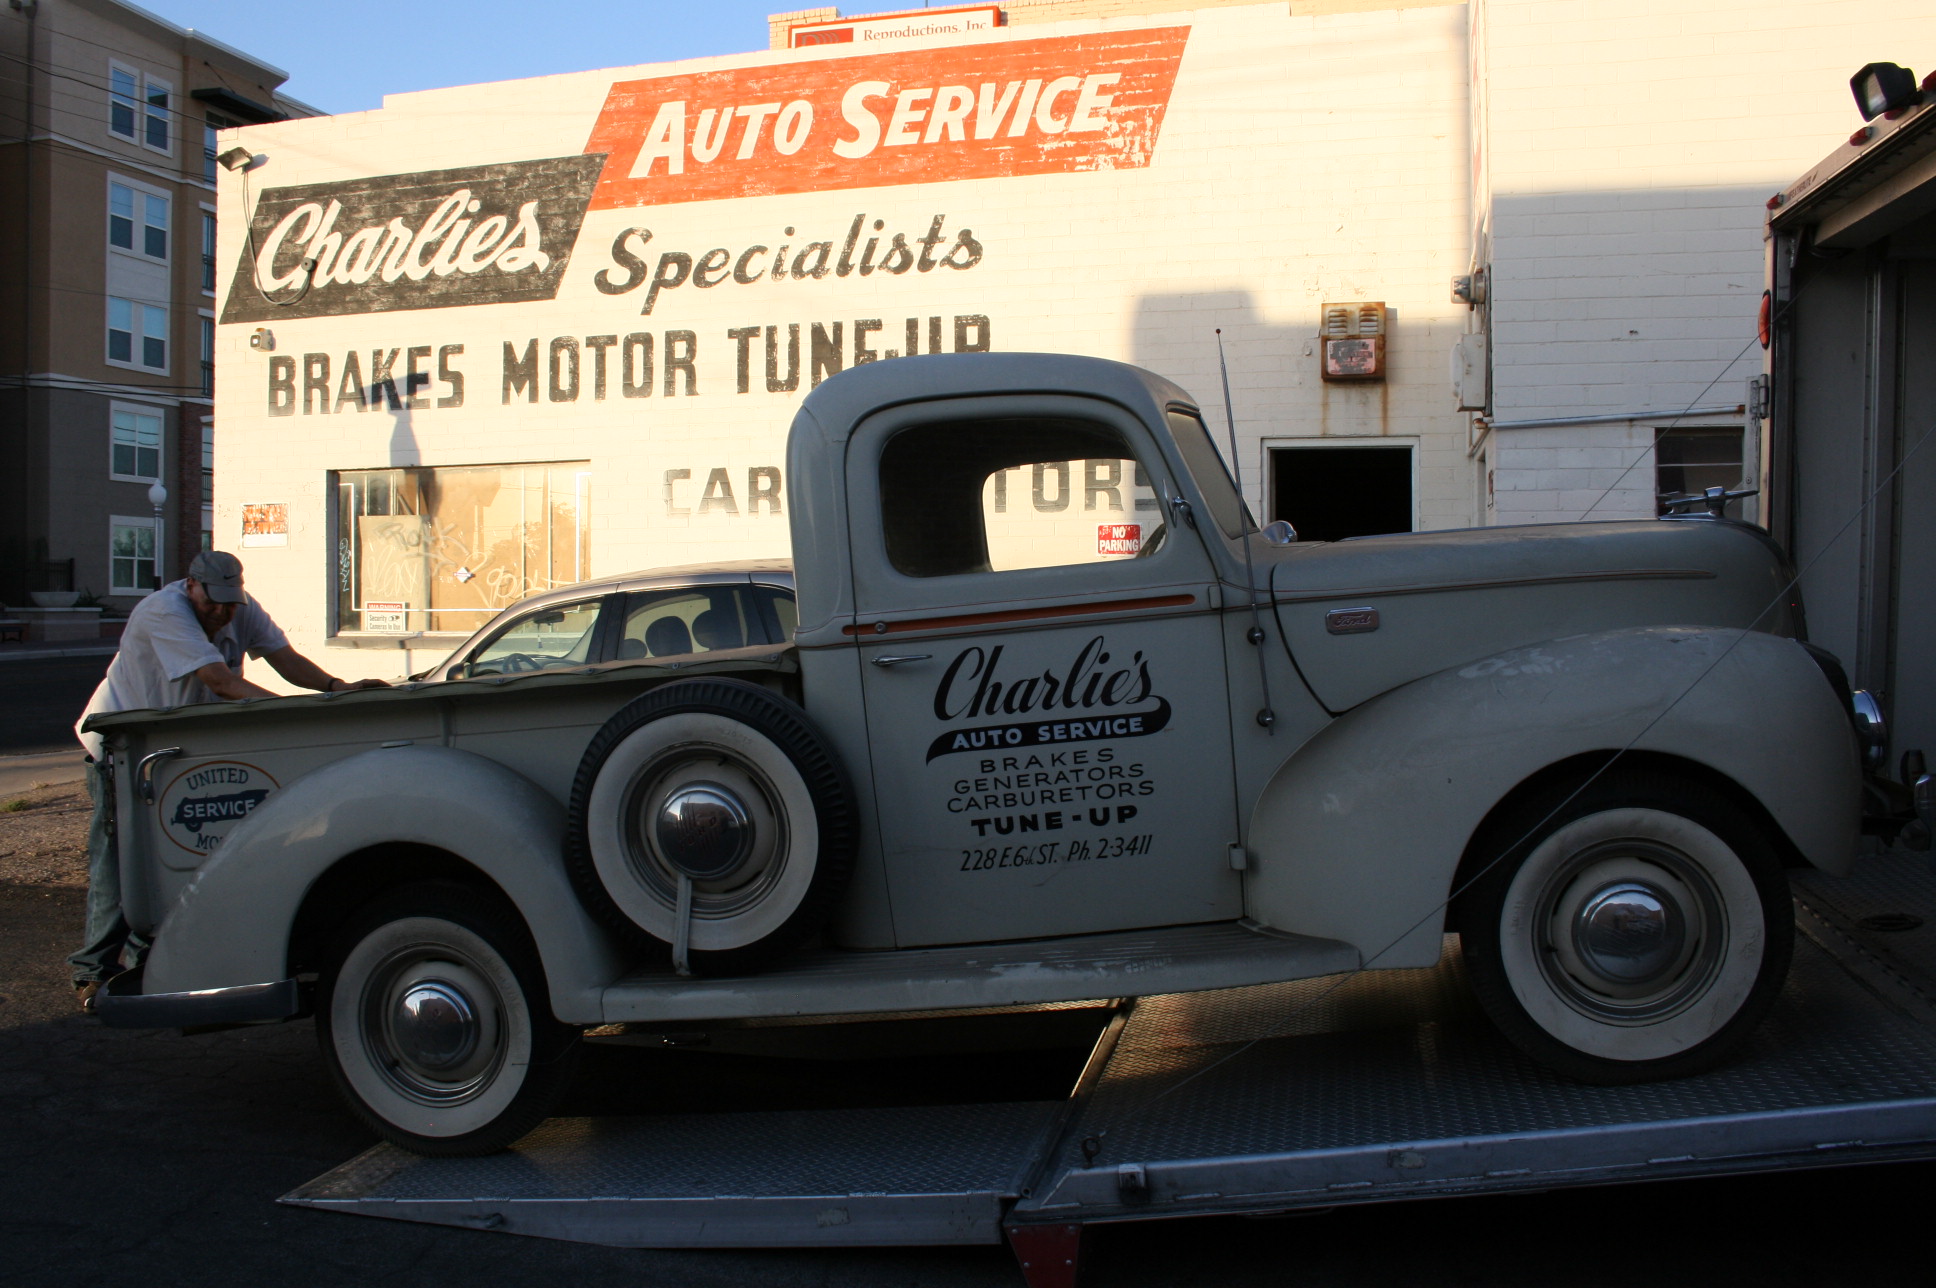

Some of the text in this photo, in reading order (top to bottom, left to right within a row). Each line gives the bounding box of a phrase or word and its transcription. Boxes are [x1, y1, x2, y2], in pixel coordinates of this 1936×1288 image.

[628, 72, 1122, 179] AUTO SERVICE
[254, 188, 550, 291] Charlies
[593, 213, 984, 316] Specialists
[268, 344, 465, 417] BRAKES
[502, 329, 699, 406] MOTOR
[1100, 539, 1139, 551] PARKING
[1112, 526, 1126, 538] NO
[1336, 614, 1371, 627] Ford
[933, 635, 1153, 721] Charlie's
[952, 717, 1144, 750] AUTO SERVICE
[980, 748, 1114, 773] BRAKES
[186, 768, 249, 790] UNITED
[954, 764, 1144, 794] GENERATORS
[183, 799, 255, 818] SERVICE
[947, 780, 1154, 813] CARBURETORS
[960, 848, 996, 871] 228
[1067, 840, 1091, 862] Ph.
